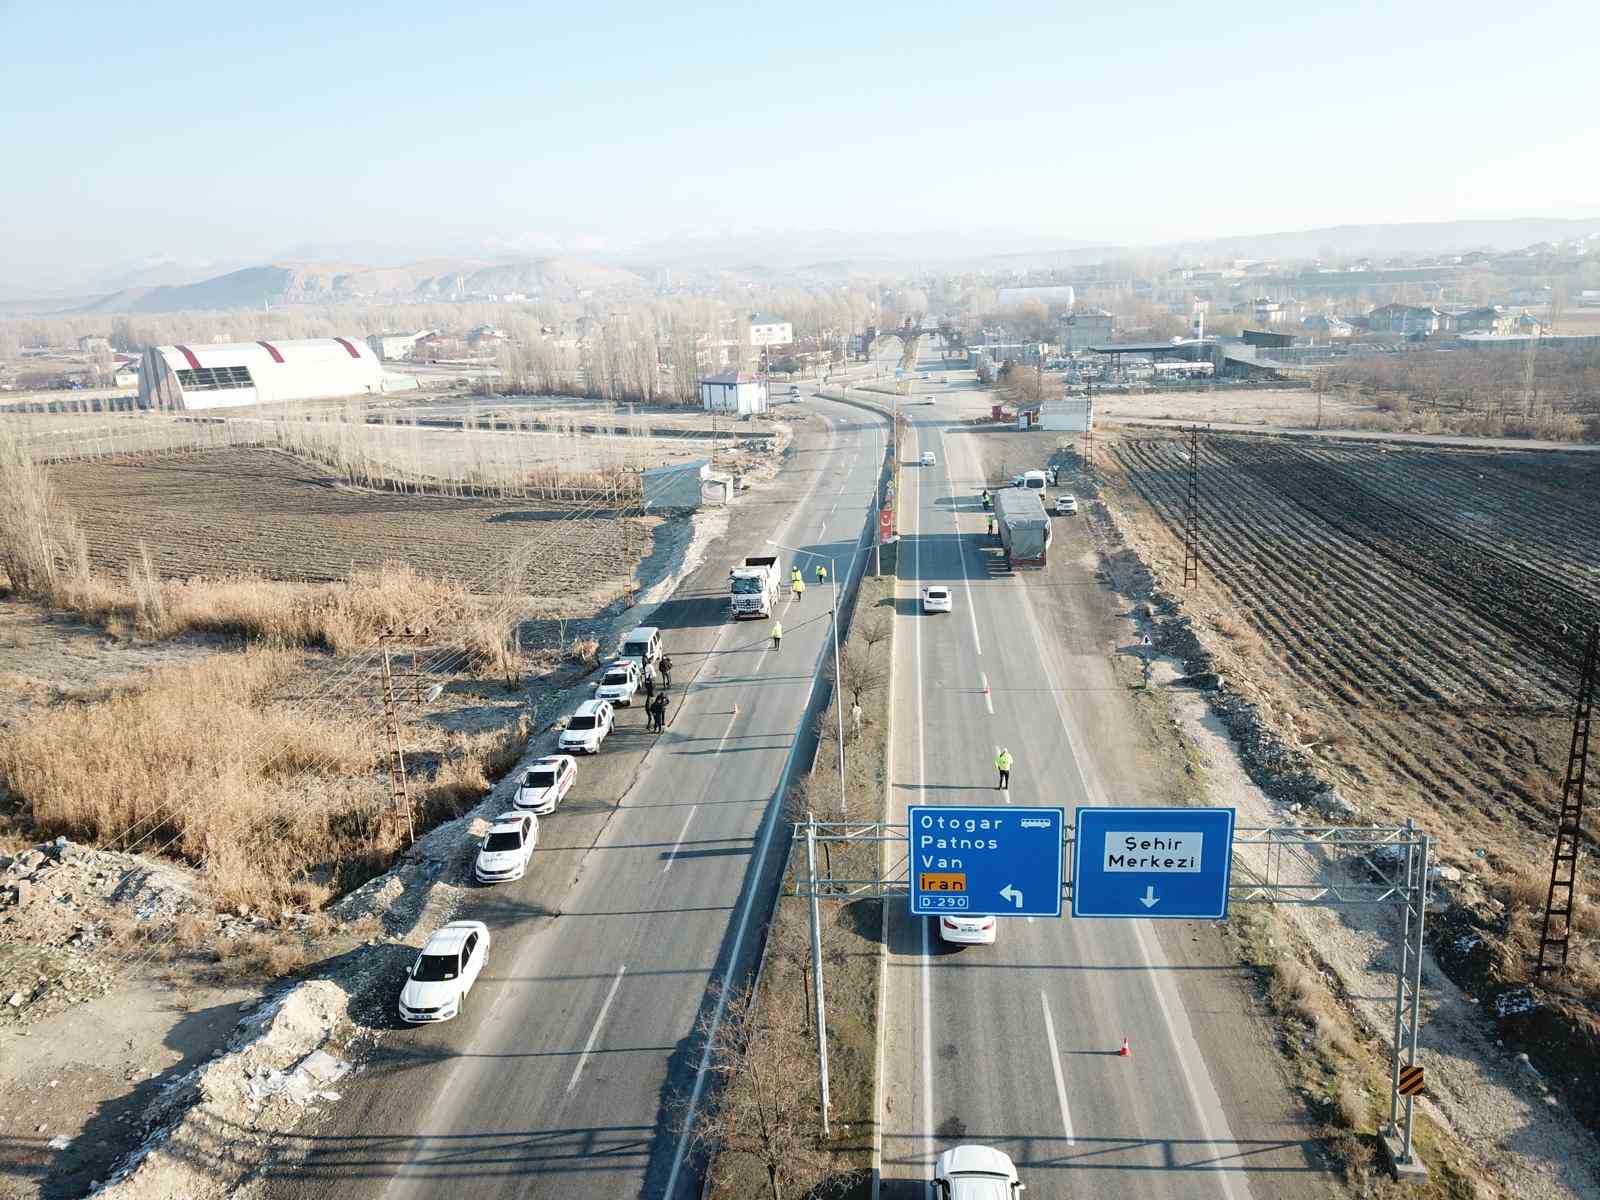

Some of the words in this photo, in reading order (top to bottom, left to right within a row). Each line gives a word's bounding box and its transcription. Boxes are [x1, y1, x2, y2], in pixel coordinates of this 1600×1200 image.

[921, 815, 1003, 833] Otogar
[921, 835, 998, 849] Patnos
[1125, 837, 1182, 851] Şehir
[922, 855, 963, 869] Van
[1108, 854, 1195, 868] Merkezi
[922, 897, 966, 907] D-290
